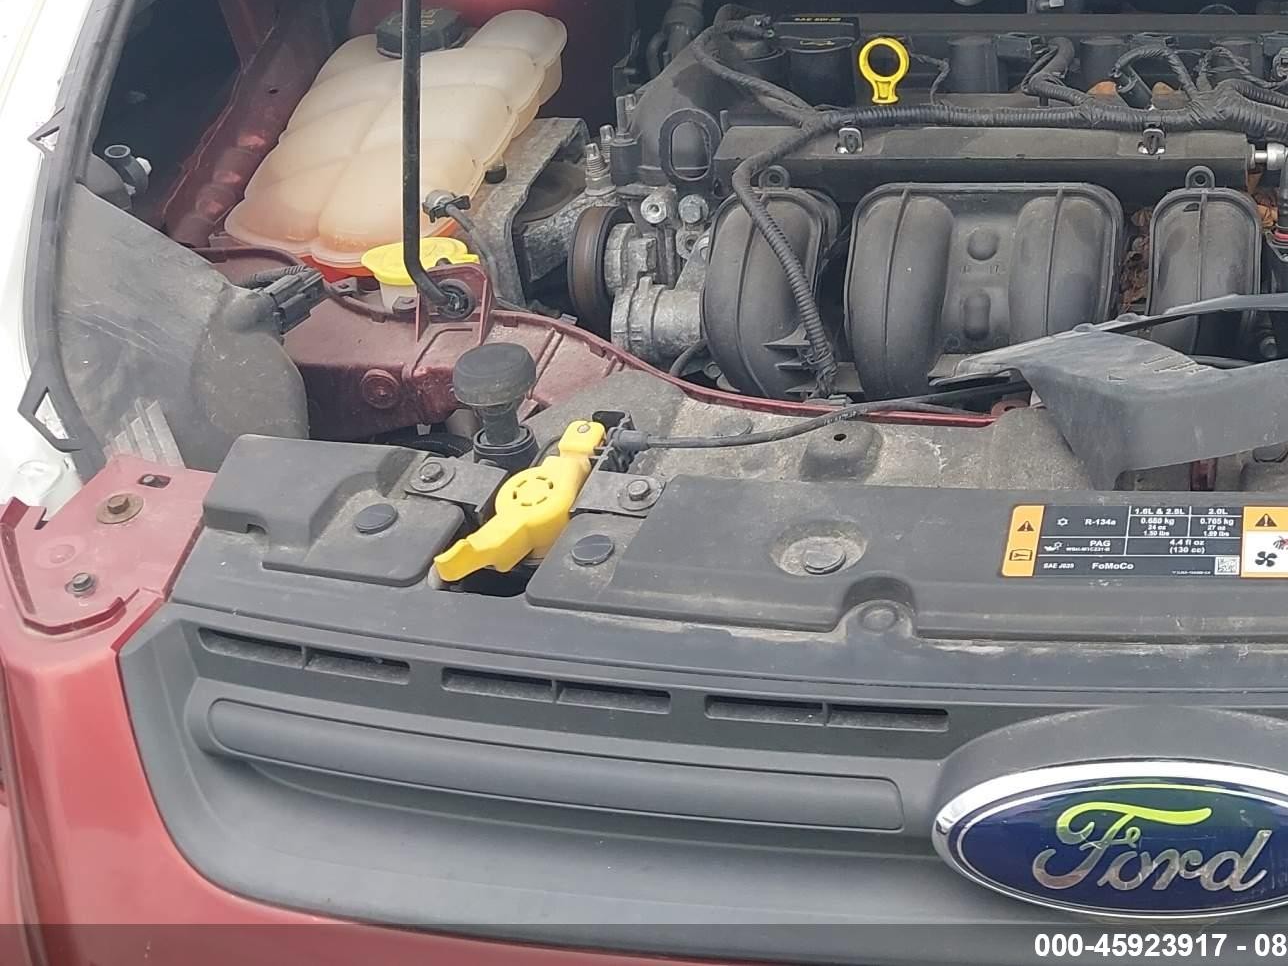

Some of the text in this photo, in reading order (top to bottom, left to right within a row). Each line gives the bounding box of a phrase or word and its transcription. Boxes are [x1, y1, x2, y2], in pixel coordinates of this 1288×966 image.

[1134, 507, 1154, 515] 1.6L
[1156, 507, 1163, 515] &
[1208, 507, 1228, 515] 2.0L
[1084, 518, 1117, 526] R-134a
[1164, 517, 1175, 525] kg
[1089, 539, 1111, 547] PAG
[1169, 546, 1205, 554] (130 cc)
[1091, 561, 1134, 571] FoMoCo
[1032, 800, 1274, 894] Ford
